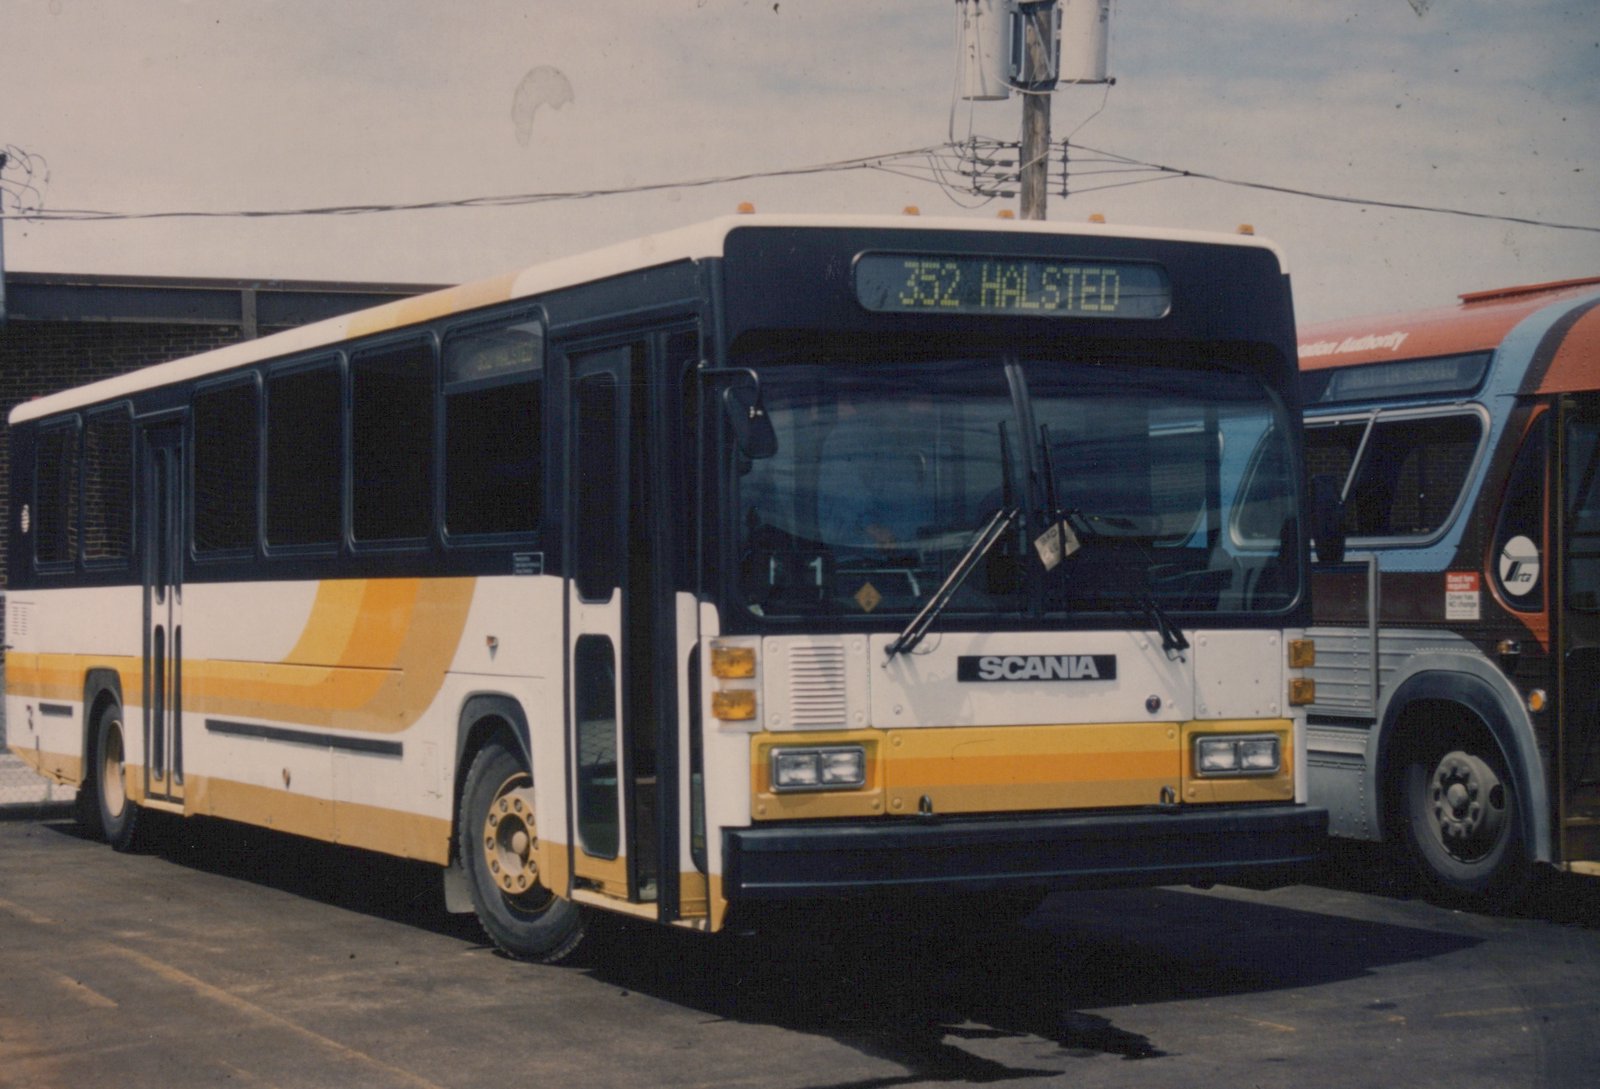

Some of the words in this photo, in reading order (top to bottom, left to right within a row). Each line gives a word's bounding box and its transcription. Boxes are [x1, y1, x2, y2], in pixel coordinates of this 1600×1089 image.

[900, 261, 960, 305] 352
[981, 264, 1120, 311] HALSTED
[978, 655, 1100, 681] SCANIA
